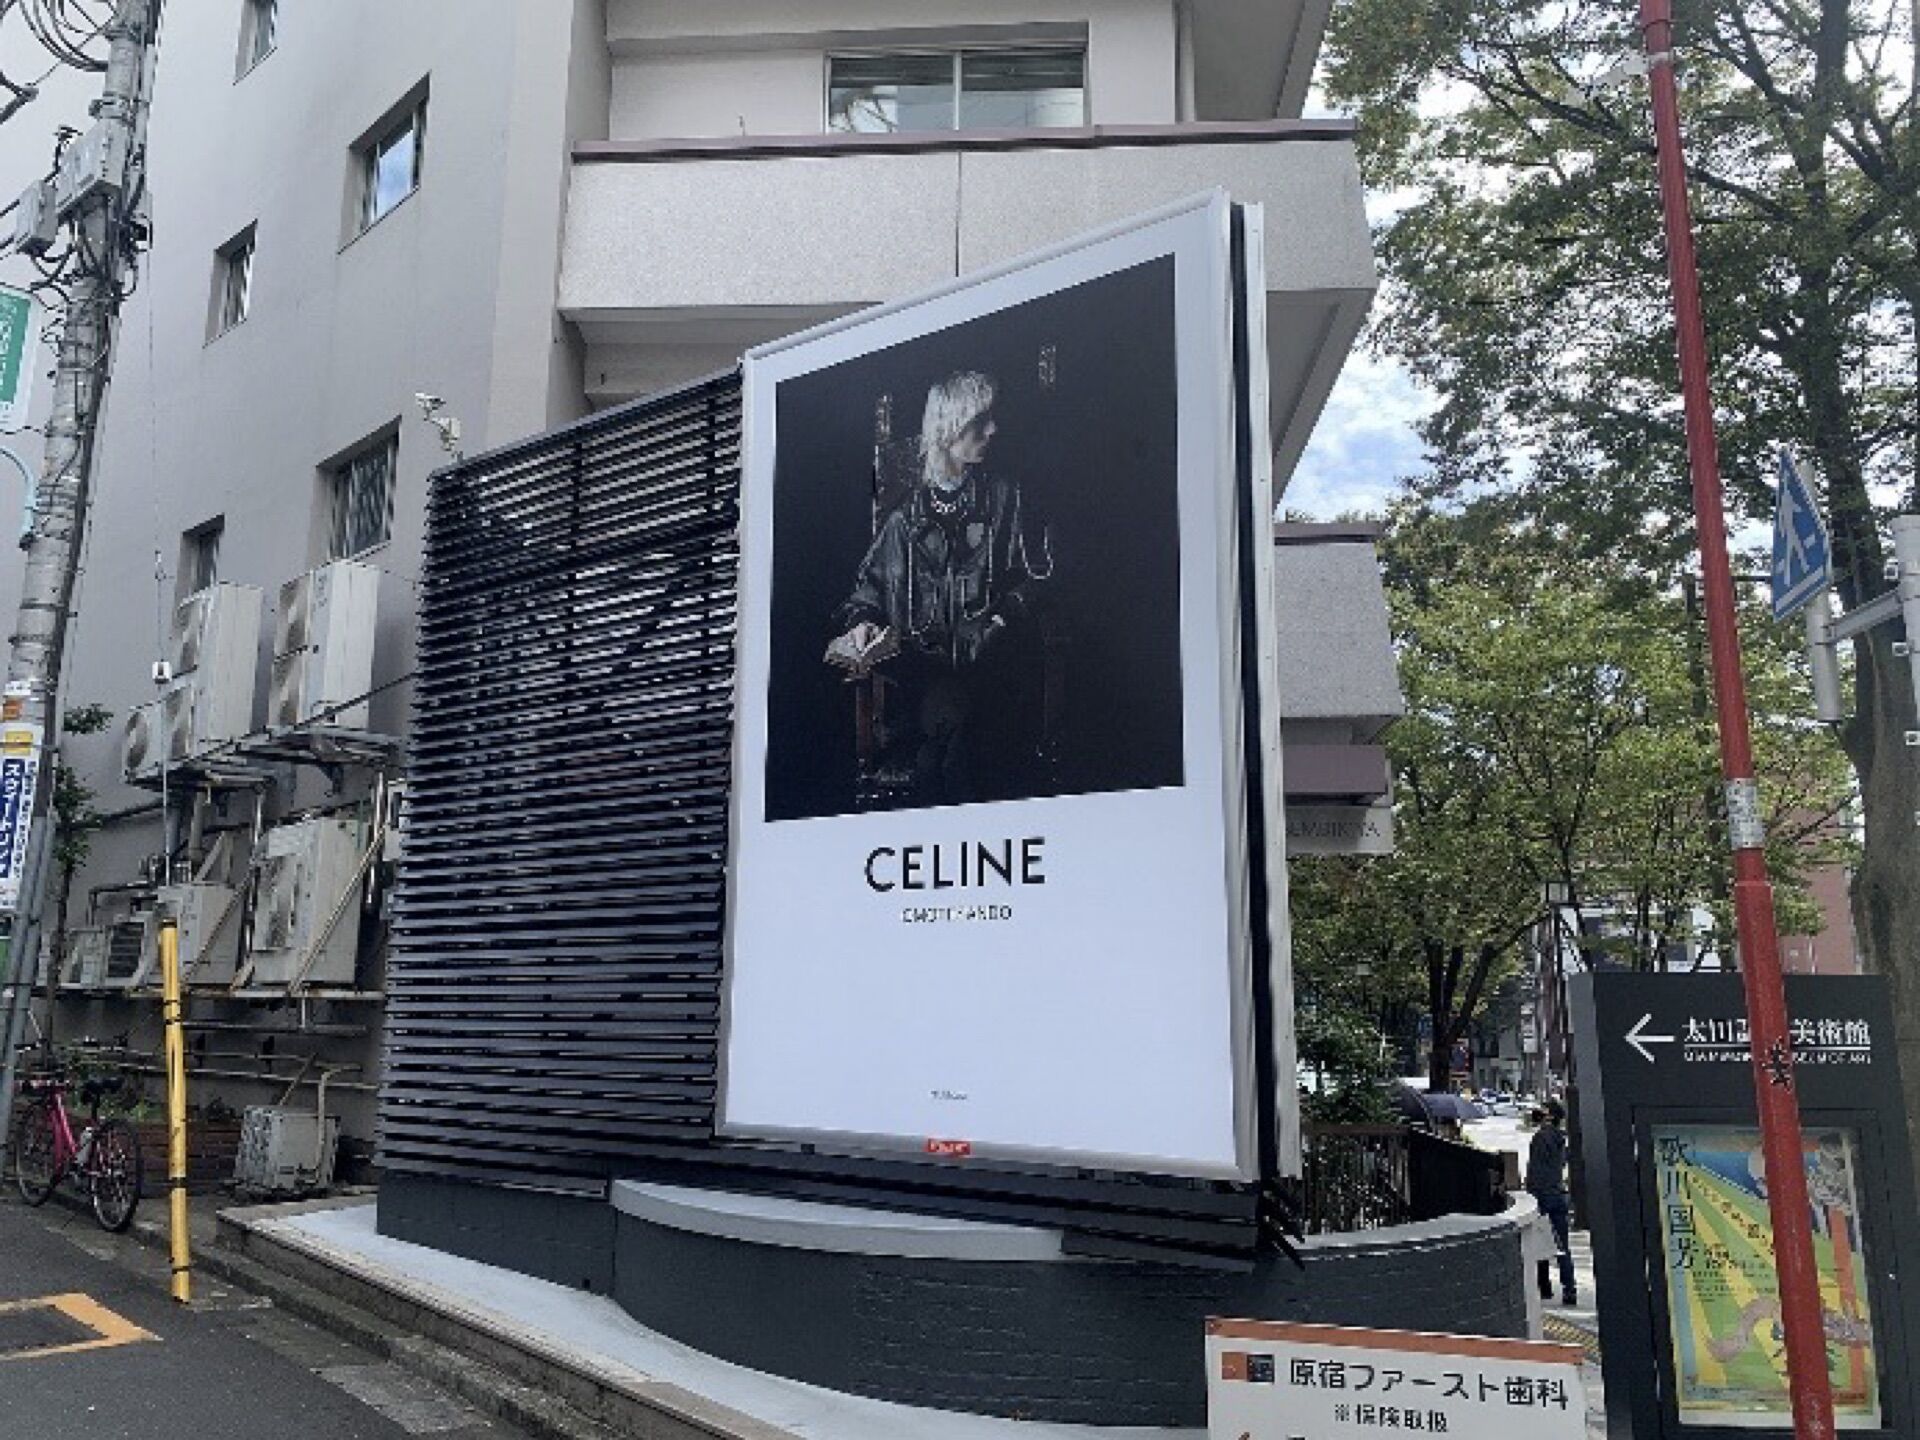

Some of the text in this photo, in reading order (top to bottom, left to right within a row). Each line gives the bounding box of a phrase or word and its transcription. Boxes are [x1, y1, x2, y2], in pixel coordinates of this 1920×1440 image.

[864, 836, 1046, 892] CELINE
[1658, 1135, 1699, 1269] 歌川国芳
[1289, 1358, 1569, 1410] 原宿ファースト歯科
